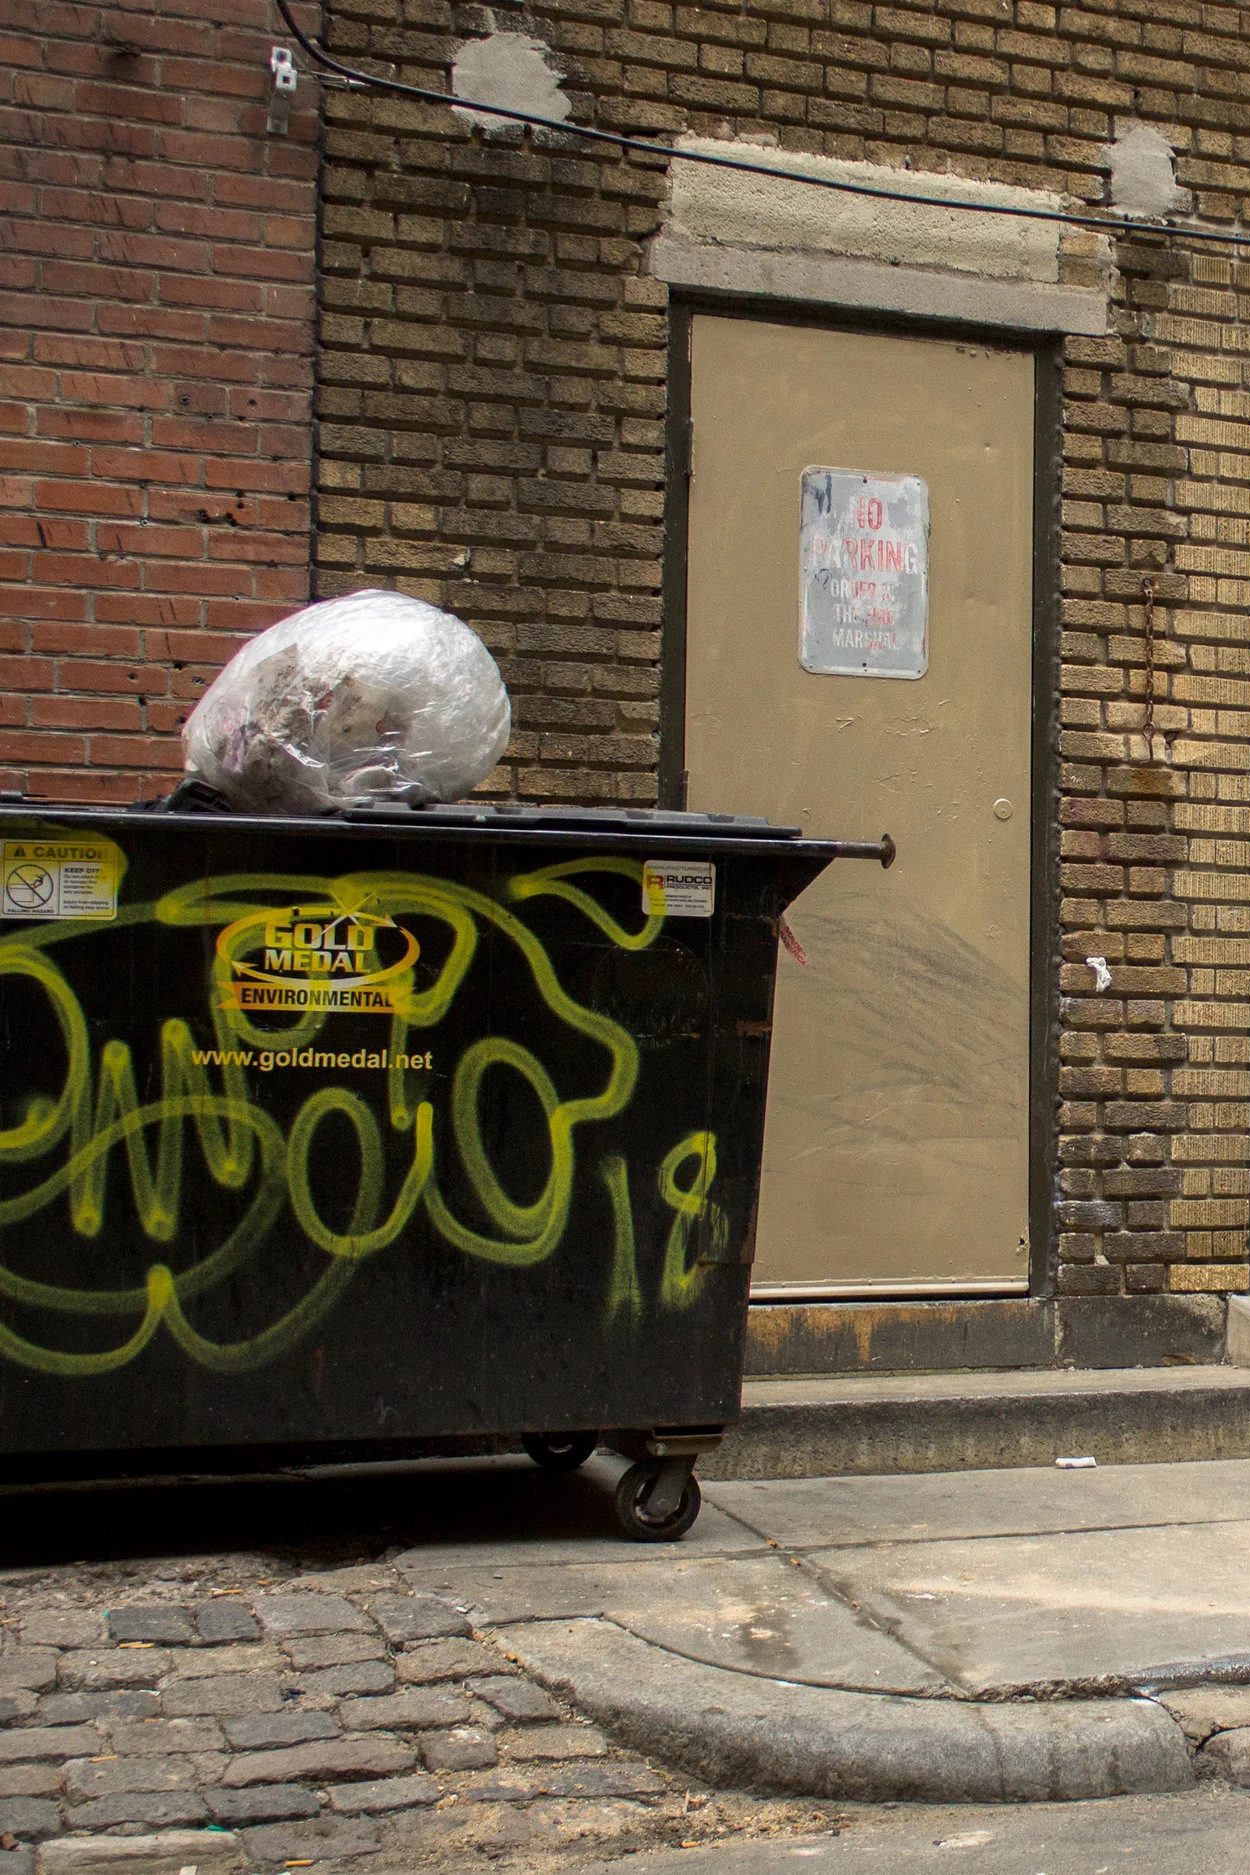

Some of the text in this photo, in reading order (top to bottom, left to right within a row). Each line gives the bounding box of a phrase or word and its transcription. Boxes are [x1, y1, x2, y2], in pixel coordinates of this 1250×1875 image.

[850, 496, 883, 530] NO
[810, 536, 919, 574] PARKING
[830, 579, 876, 600] ORDER
[835, 604, 894, 626] THE FIRE
[832, 629, 898, 650] MARSHAL
[667, 875, 713, 884] RUDCO
[265, 922, 374, 950] GOLD
[265, 950, 371, 973] MEDAL
[241, 988, 394, 1008] ENVIRONMENTAL
[191, 1048, 433, 1072] www.goldmedal.net
